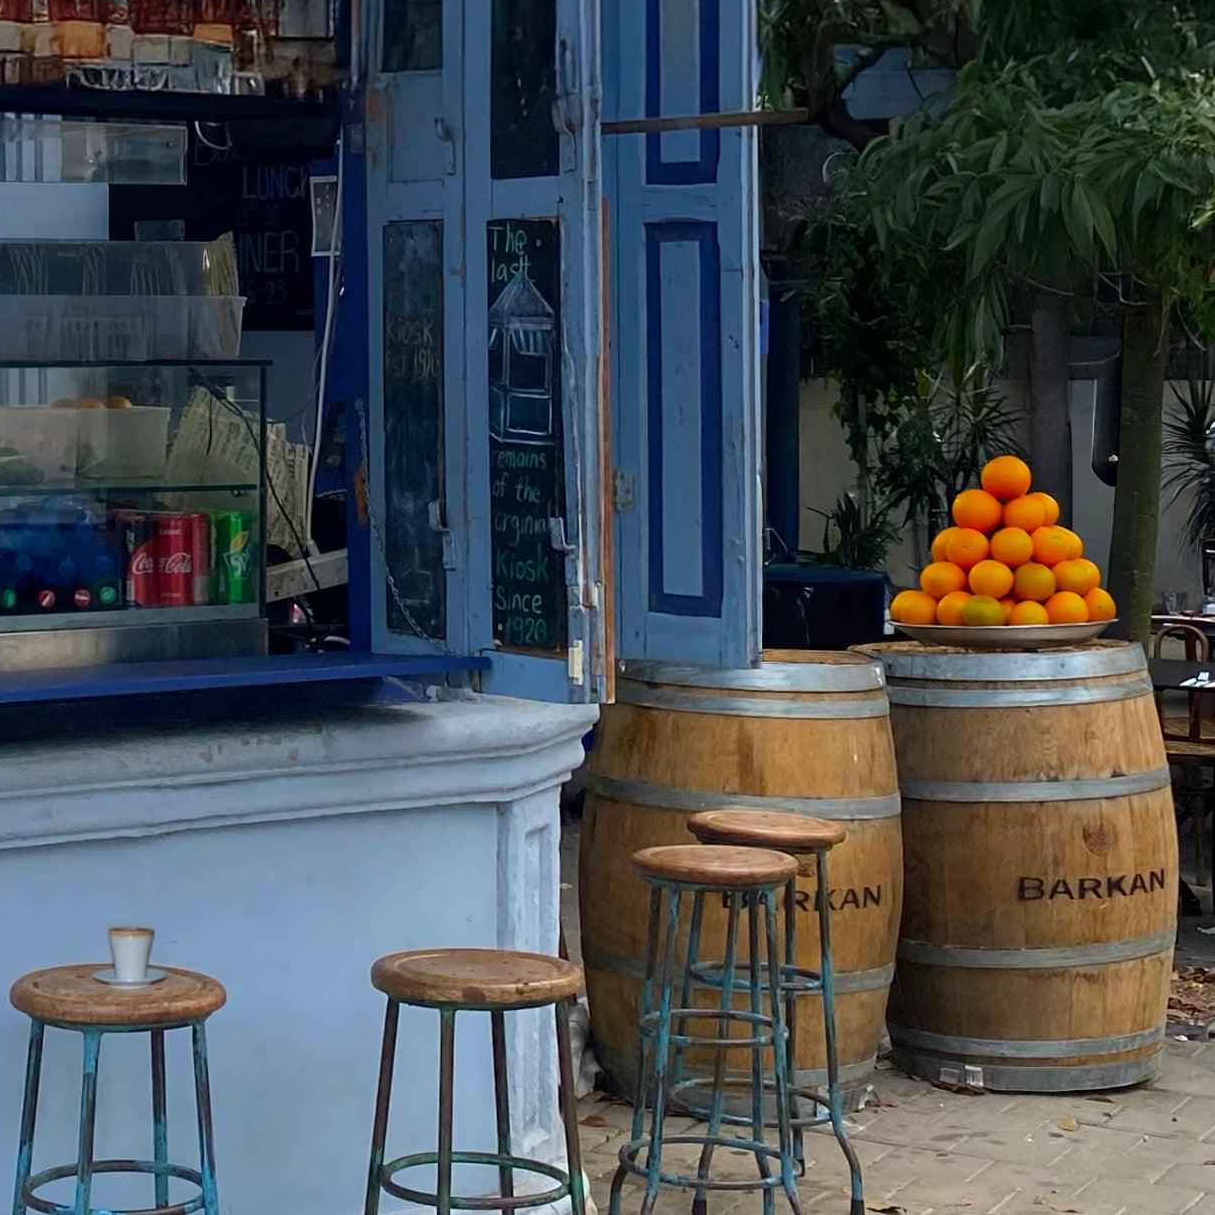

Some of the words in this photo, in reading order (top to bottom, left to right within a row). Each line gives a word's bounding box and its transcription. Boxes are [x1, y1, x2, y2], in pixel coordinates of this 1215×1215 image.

[488, 221, 528, 256] The
[491, 449, 548, 470] remains
[492, 471, 510, 498] of
[514, 475, 540, 503] the
[495, 543, 549, 582] Kiosk
[494, 585, 543, 614] Since
[1017, 868, 1165, 901] BARKAN
